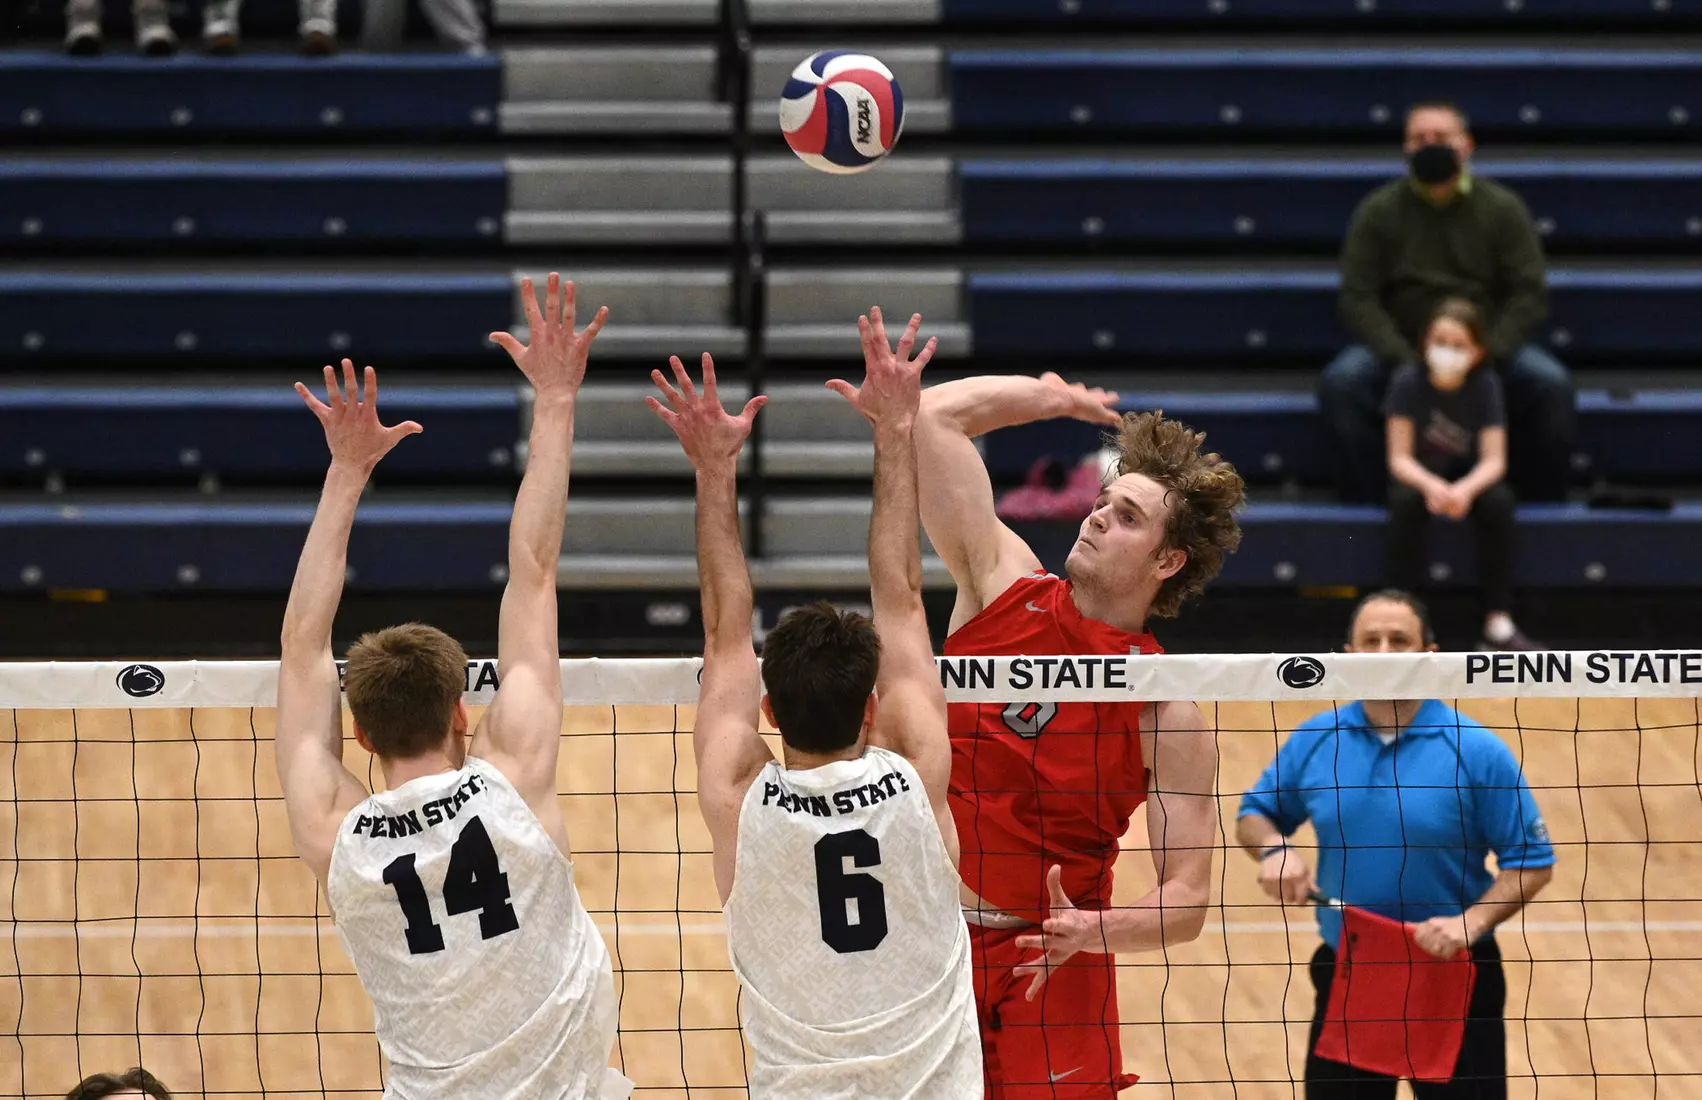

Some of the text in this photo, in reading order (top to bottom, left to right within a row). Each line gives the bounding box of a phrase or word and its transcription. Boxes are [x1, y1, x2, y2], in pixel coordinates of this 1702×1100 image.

[857, 99, 872, 144] NCAA
[936, 658, 1127, 690] NN STATE
[1466, 652, 1702, 684] PENN STATE
[763, 782, 831, 817] PENN
[353, 809, 423, 838] PENN
[382, 815, 519, 954] 14
[814, 828, 888, 953] 6
